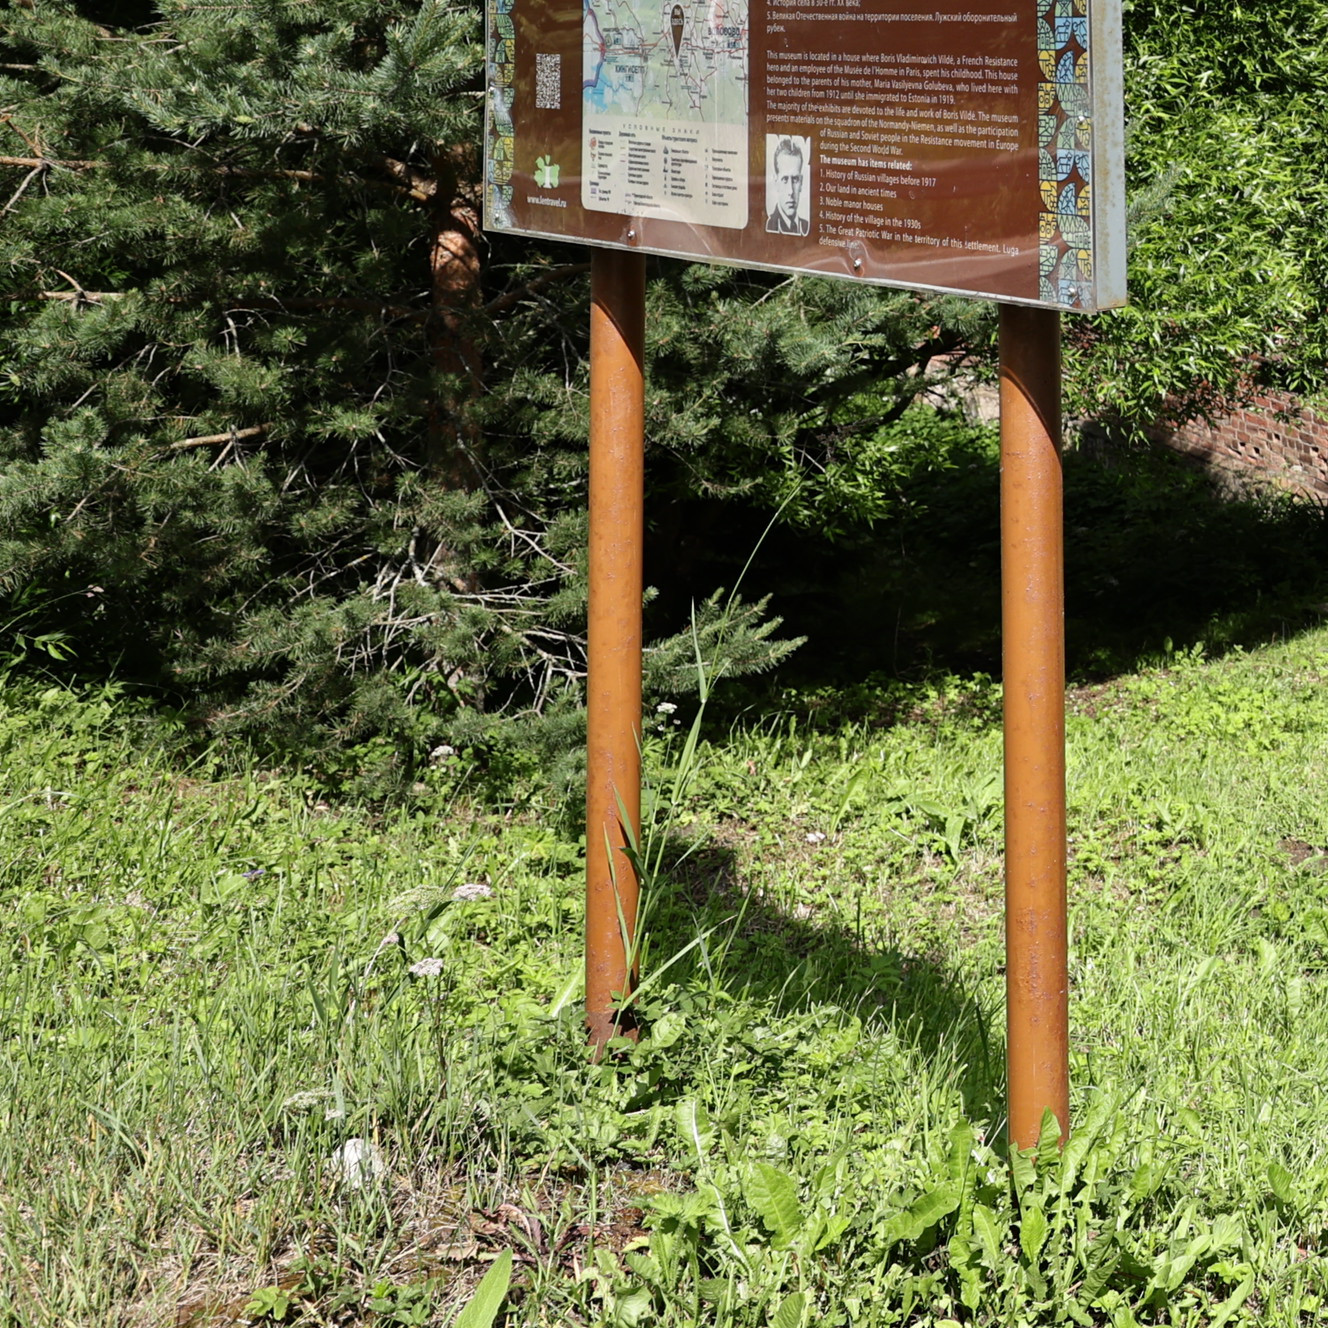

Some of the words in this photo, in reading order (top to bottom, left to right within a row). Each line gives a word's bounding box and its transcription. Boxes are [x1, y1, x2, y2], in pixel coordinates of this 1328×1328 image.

[772, 11, 795, 20] Великая
[796, 11, 837, 20] Отечественная
[839, 12, 855, 21] война
[865, 14, 899, 23] территории
[935, 12, 961, 23] Лужский
[963, 12, 1017, 24] оборонительный
[767, 75, 792, 86] belonged
[793, 76, 799, 85] to
[801, 76, 810, 85] the
[811, 77, 832, 87] parents
[833, 77, 839, 86] of
[841, 78, 849, 87] his
[874, 79, 890, 88] Maria
[891, 80, 922, 91] Vasilyevna
[956, 82, 969, 92] who
[971, 82, 986, 93] lived
[987, 83, 1002, 93] here
[1004, 84, 1018, 94] with
[767, 87, 775, 96] her
[777, 87, 787, 96] two
[788, 88, 810, 97] children
[811, 89, 824, 98] from
[826, 89, 839, 99] 1912
[840, 90, 853, 99] until
[855, 90, 864, 100] she
[866, 91, 899, 102] immigrated
[900, 92, 907, 102] to
[908, 93, 929, 103] Estonia
[931, 94, 937, 103] in
[939, 94, 955, 104] 1919.
[820, 129, 825, 138] of
[827, 129, 848, 139] Russian
[849, 131, 860, 140] and
[861, 131, 879, 141] Soviet
[880, 133, 900, 144] people
[902, 134, 908, 143] in
[909, 134, 919, 144] the
[920, 134, 952, 146] Resistance
[953, 138, 986, 148] movement
[988, 139, 994, 148] in
[996, 139, 1019, 152] Europe
[820, 156, 830, 165] The
[832, 159, 856, 167] museum
[858, 158, 868, 168] has
[870, 159, 886, 169] items
[888, 160, 912, 170] related:
[826, 169, 845, 181] History
[847, 171, 853, 180] of
[854, 171, 876, 182] Russian
[877, 173, 899, 185] villages
[900, 175, 920, 185] before
[922, 176, 936, 186] 1917
[826, 183, 836, 193] Our
[837, 184, 850, 194] land
[851, 186, 856, 194] in
[858, 187, 879, 197] ancient
[880, 188, 896, 198] times
[826, 197, 842, 207] Noble
[843, 201, 861, 209] manor
[863, 200, 883, 211] houses
[826, 210, 845, 222] History
[847, 213, 852, 222] of
[854, 213, 863, 223] the
[865, 215, 884, 226] village
[885, 216, 891, 226] in
[892, 217, 902, 227] the
[904, 218, 921, 229] 1930s
[820, 224, 824, 233] 5.
[826, 224, 836, 234] The
[838, 226, 853, 236] Great
[855, 227, 879, 239] Patriotic
[881, 230, 892, 240] War
[894, 231, 900, 241] in
[902, 232, 912, 242] the
[914, 233, 940, 247] territory
[942, 236, 948, 246] of
[950, 237, 962, 248] this
[1002, 243, 1019, 255] Luga
